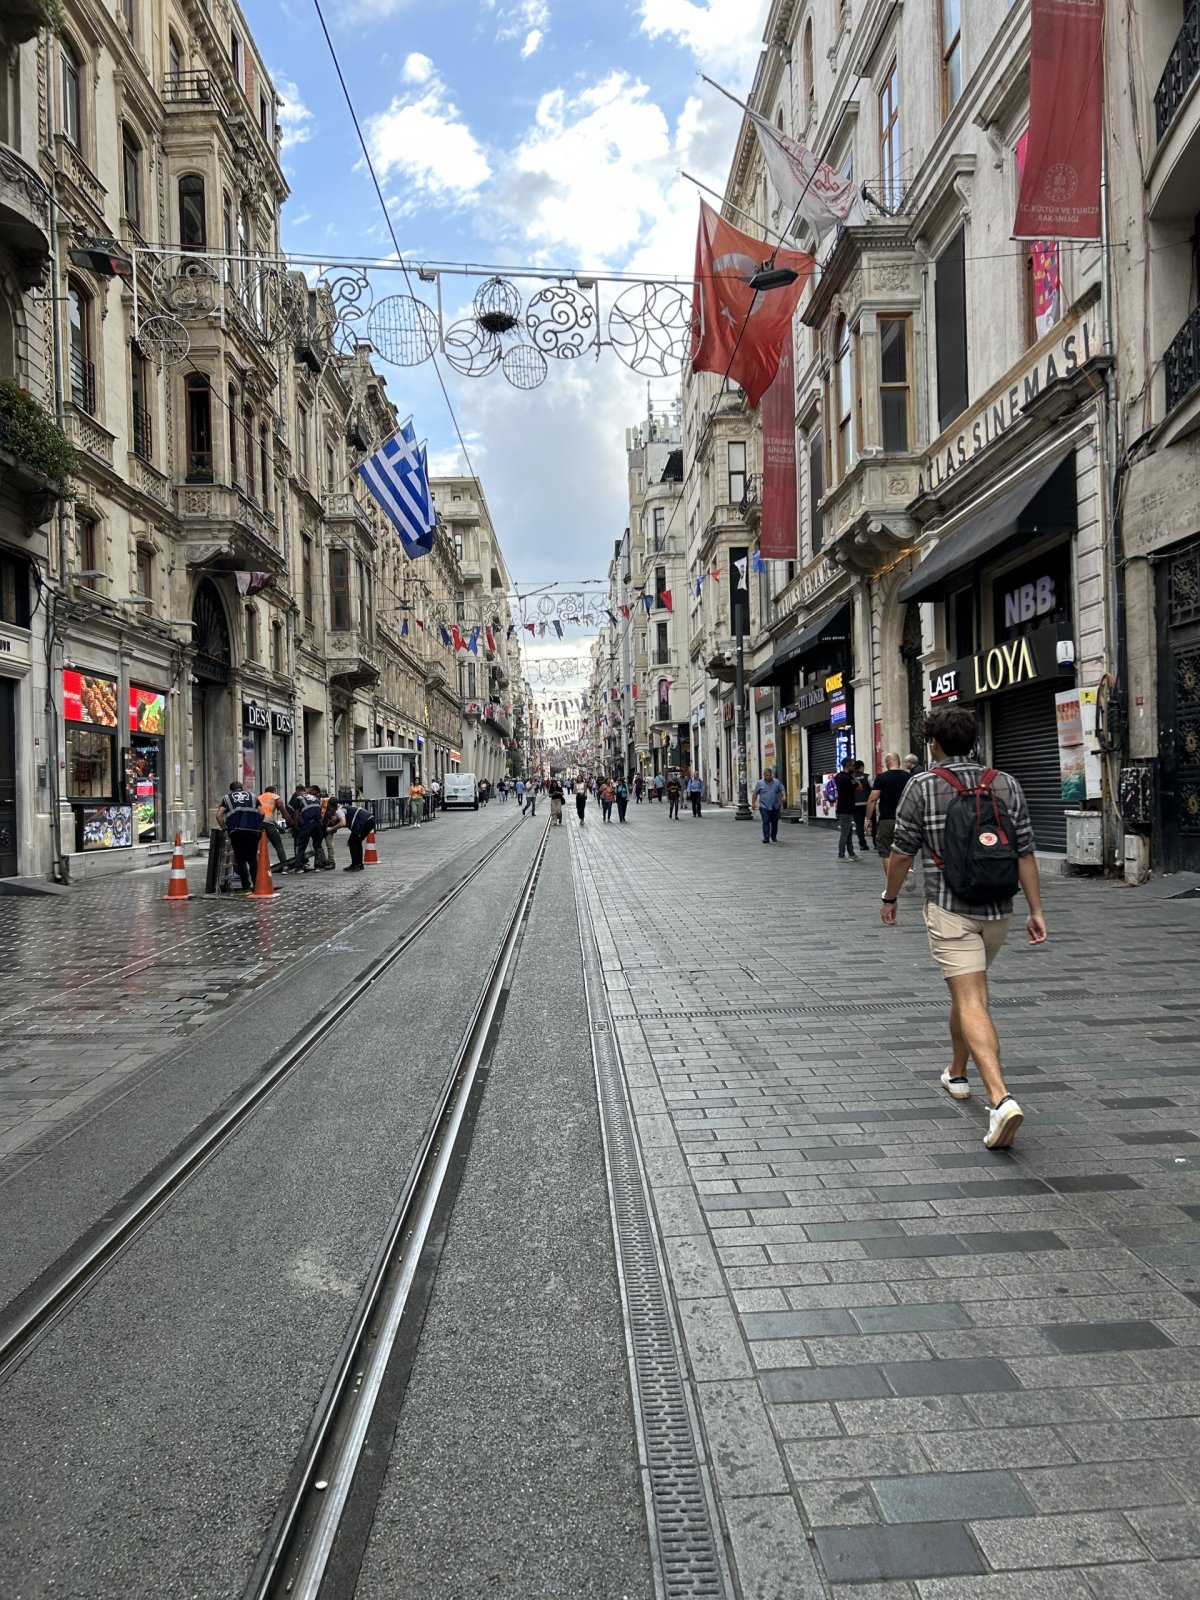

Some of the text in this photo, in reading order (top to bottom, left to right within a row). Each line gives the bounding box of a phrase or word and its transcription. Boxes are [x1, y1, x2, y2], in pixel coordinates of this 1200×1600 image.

[1061, 207, 1071, 215] VE
[917, 435, 967, 494] ATLAS
[1004, 576, 1054, 628] NBB
[825, 671, 843, 693] CHANGE
[929, 670, 956, 698] LAST
[249, 705, 271, 728] DESA
[276, 714, 294, 734] DESA
